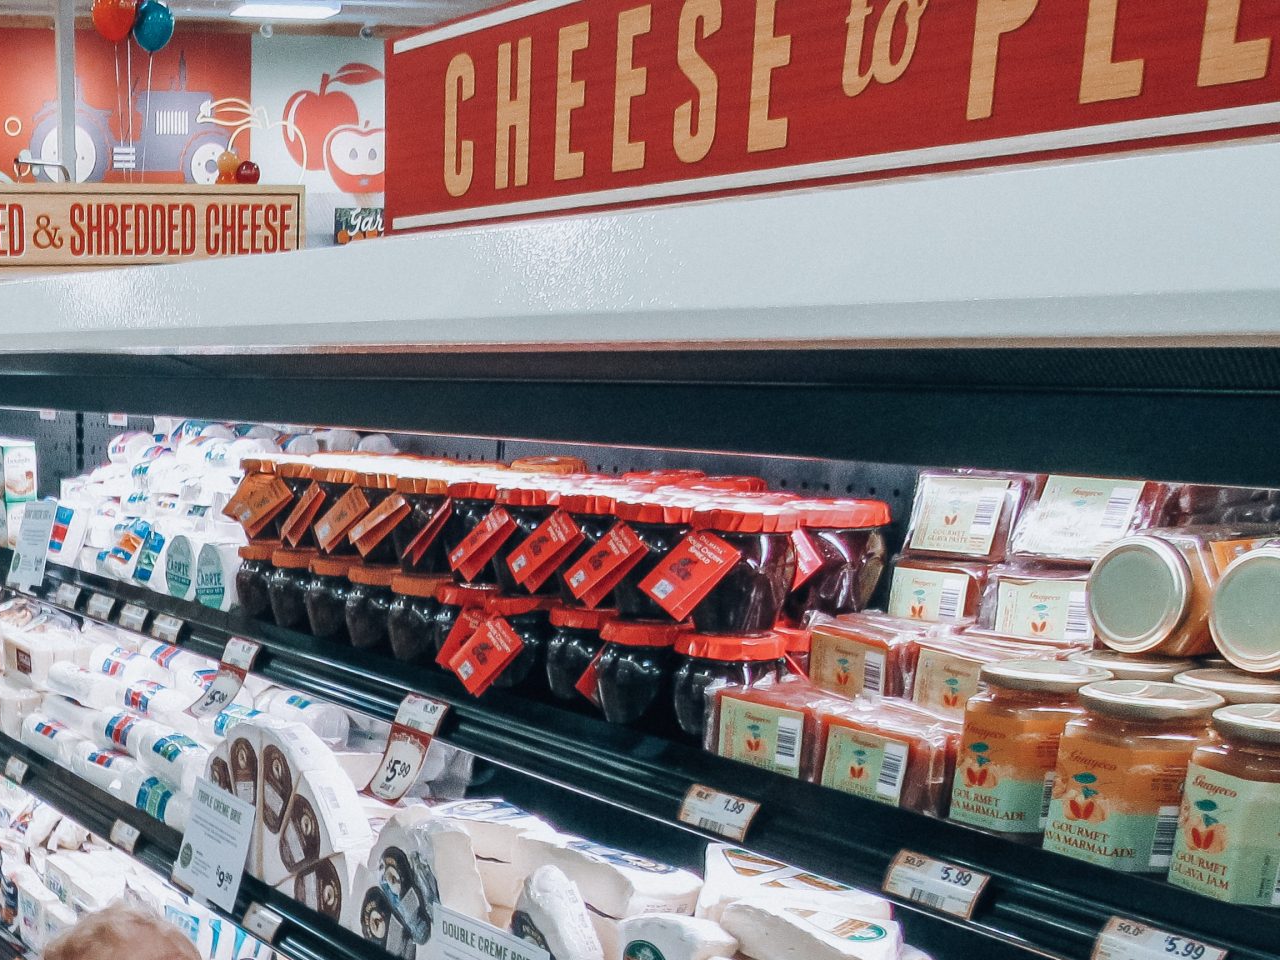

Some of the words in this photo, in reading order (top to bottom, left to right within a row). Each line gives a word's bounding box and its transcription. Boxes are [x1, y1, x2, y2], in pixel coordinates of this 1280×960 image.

[443, 0, 791, 197] CHEESE
[841, 0, 928, 97] to
[32, 214, 64, 249] &
[70, 202, 196, 257] SHREDDED
[205, 203, 291, 256] CHEESE
[1052, 820, 1109, 844] GOURMET
[1063, 832, 1136, 858] MARMALADE
[1175, 852, 1228, 876] GOURMET
[1205, 873, 1229, 891] JAM
[442, 920, 476, 947] DOUBLE
